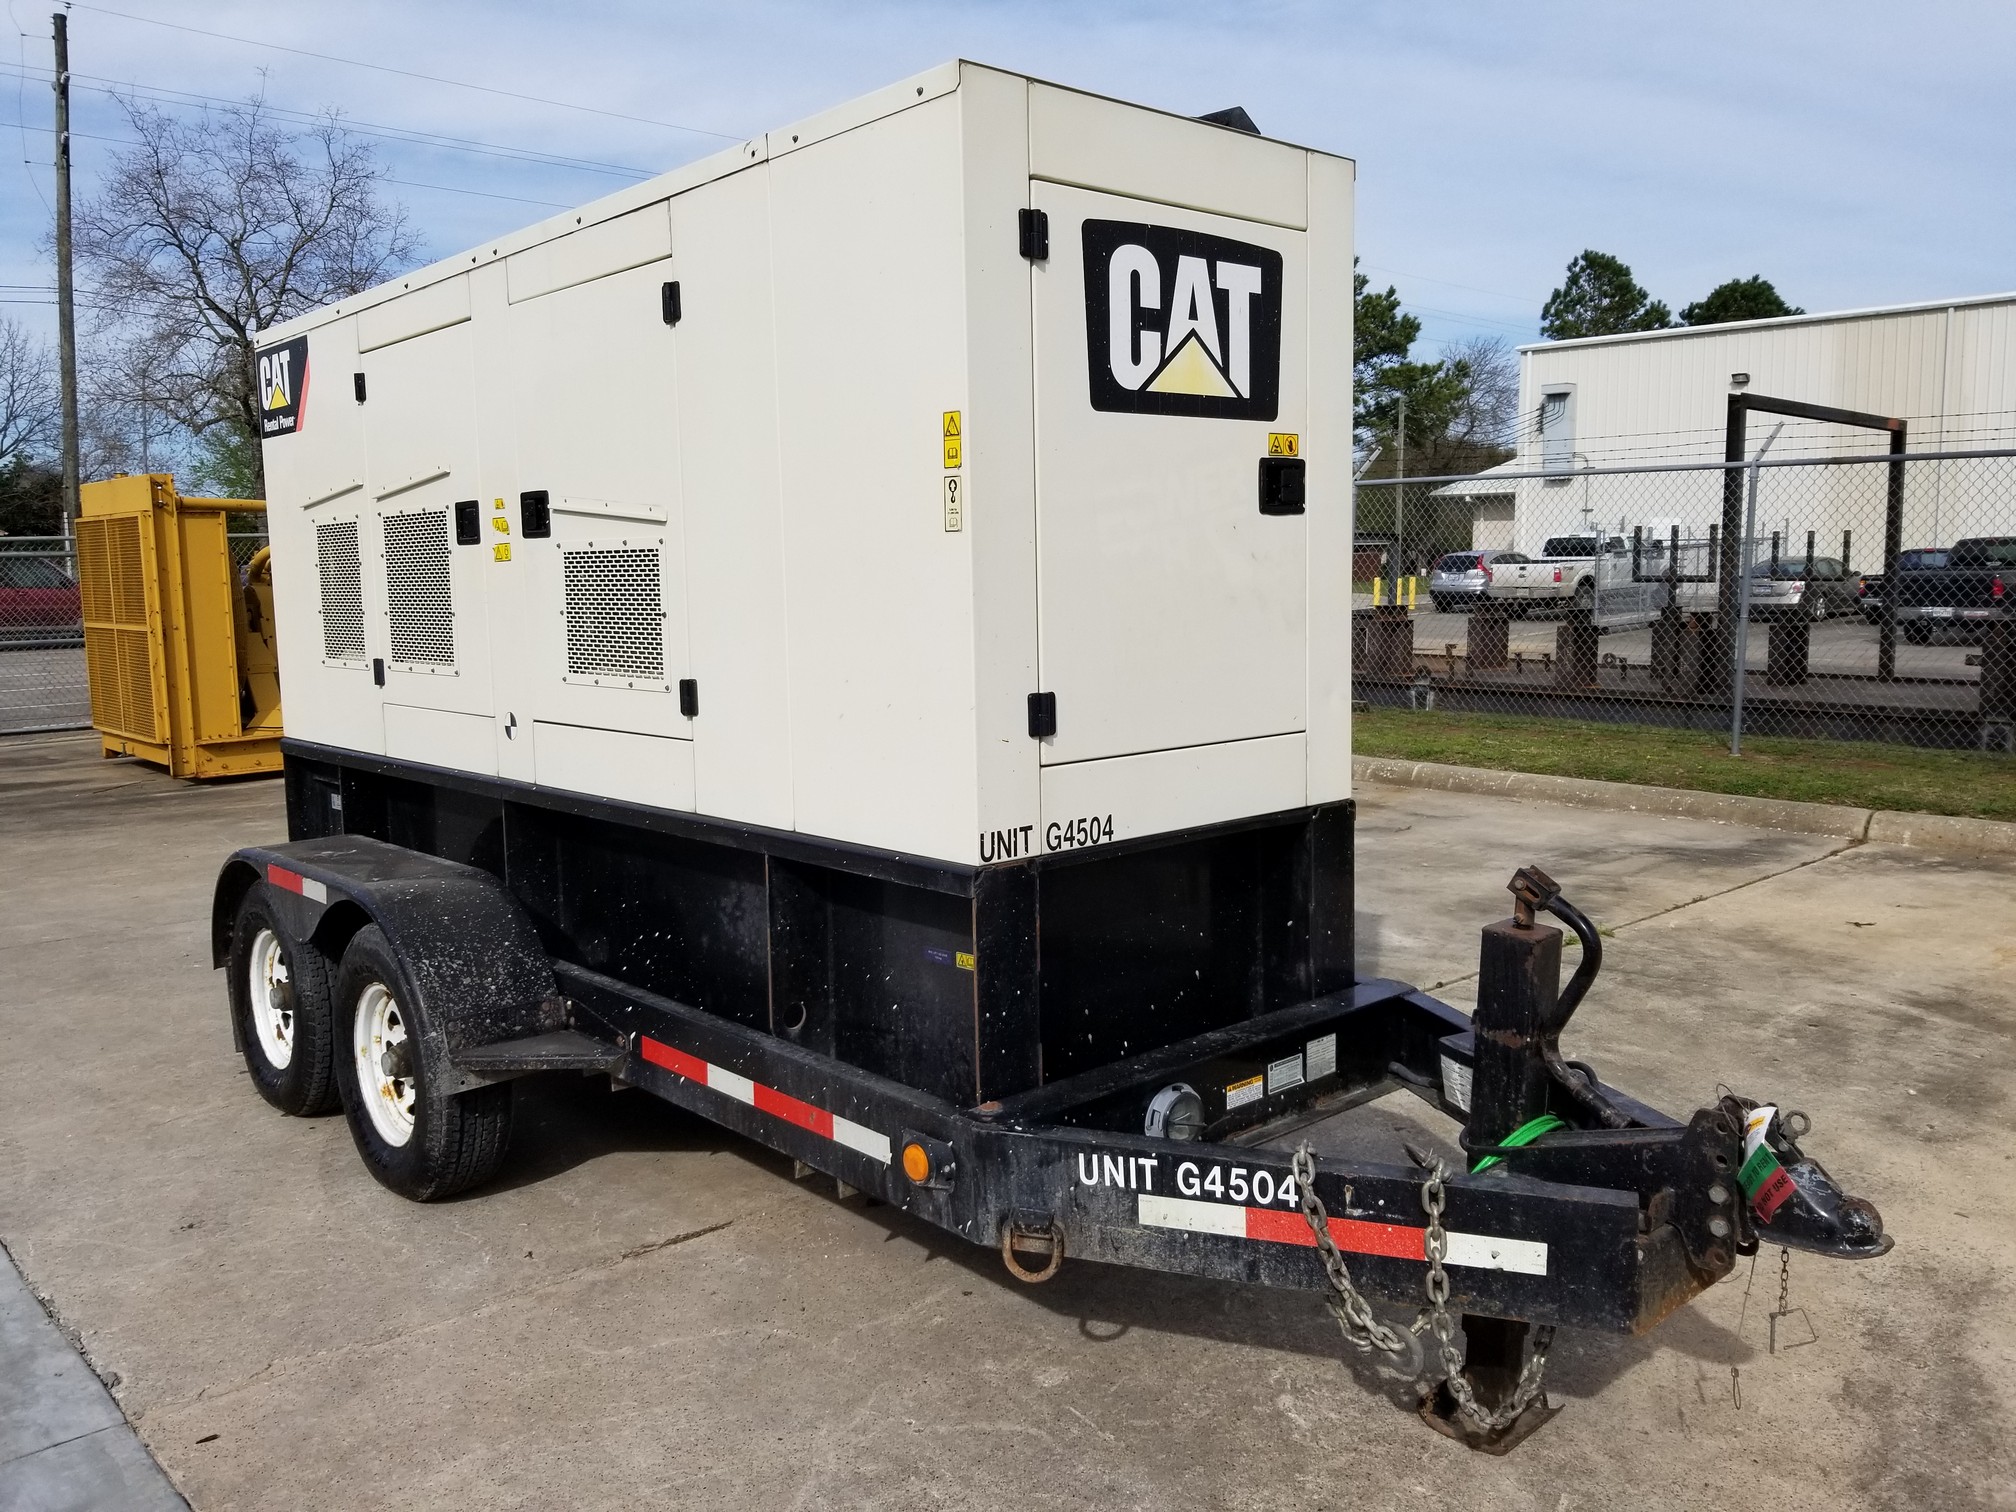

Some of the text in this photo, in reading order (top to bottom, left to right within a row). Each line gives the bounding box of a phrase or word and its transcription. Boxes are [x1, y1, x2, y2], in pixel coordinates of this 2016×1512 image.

[1109, 244, 1262, 399] CAT
[260, 350, 291, 411] CAT
[264, 415, 295, 432] Rental Power
[980, 814, 1114, 862] UNIT G4504
[1078, 1153, 1299, 1208] UNIT G4504
[1761, 1189, 1774, 1206] NOT
[1772, 1175, 1788, 1192] USE
